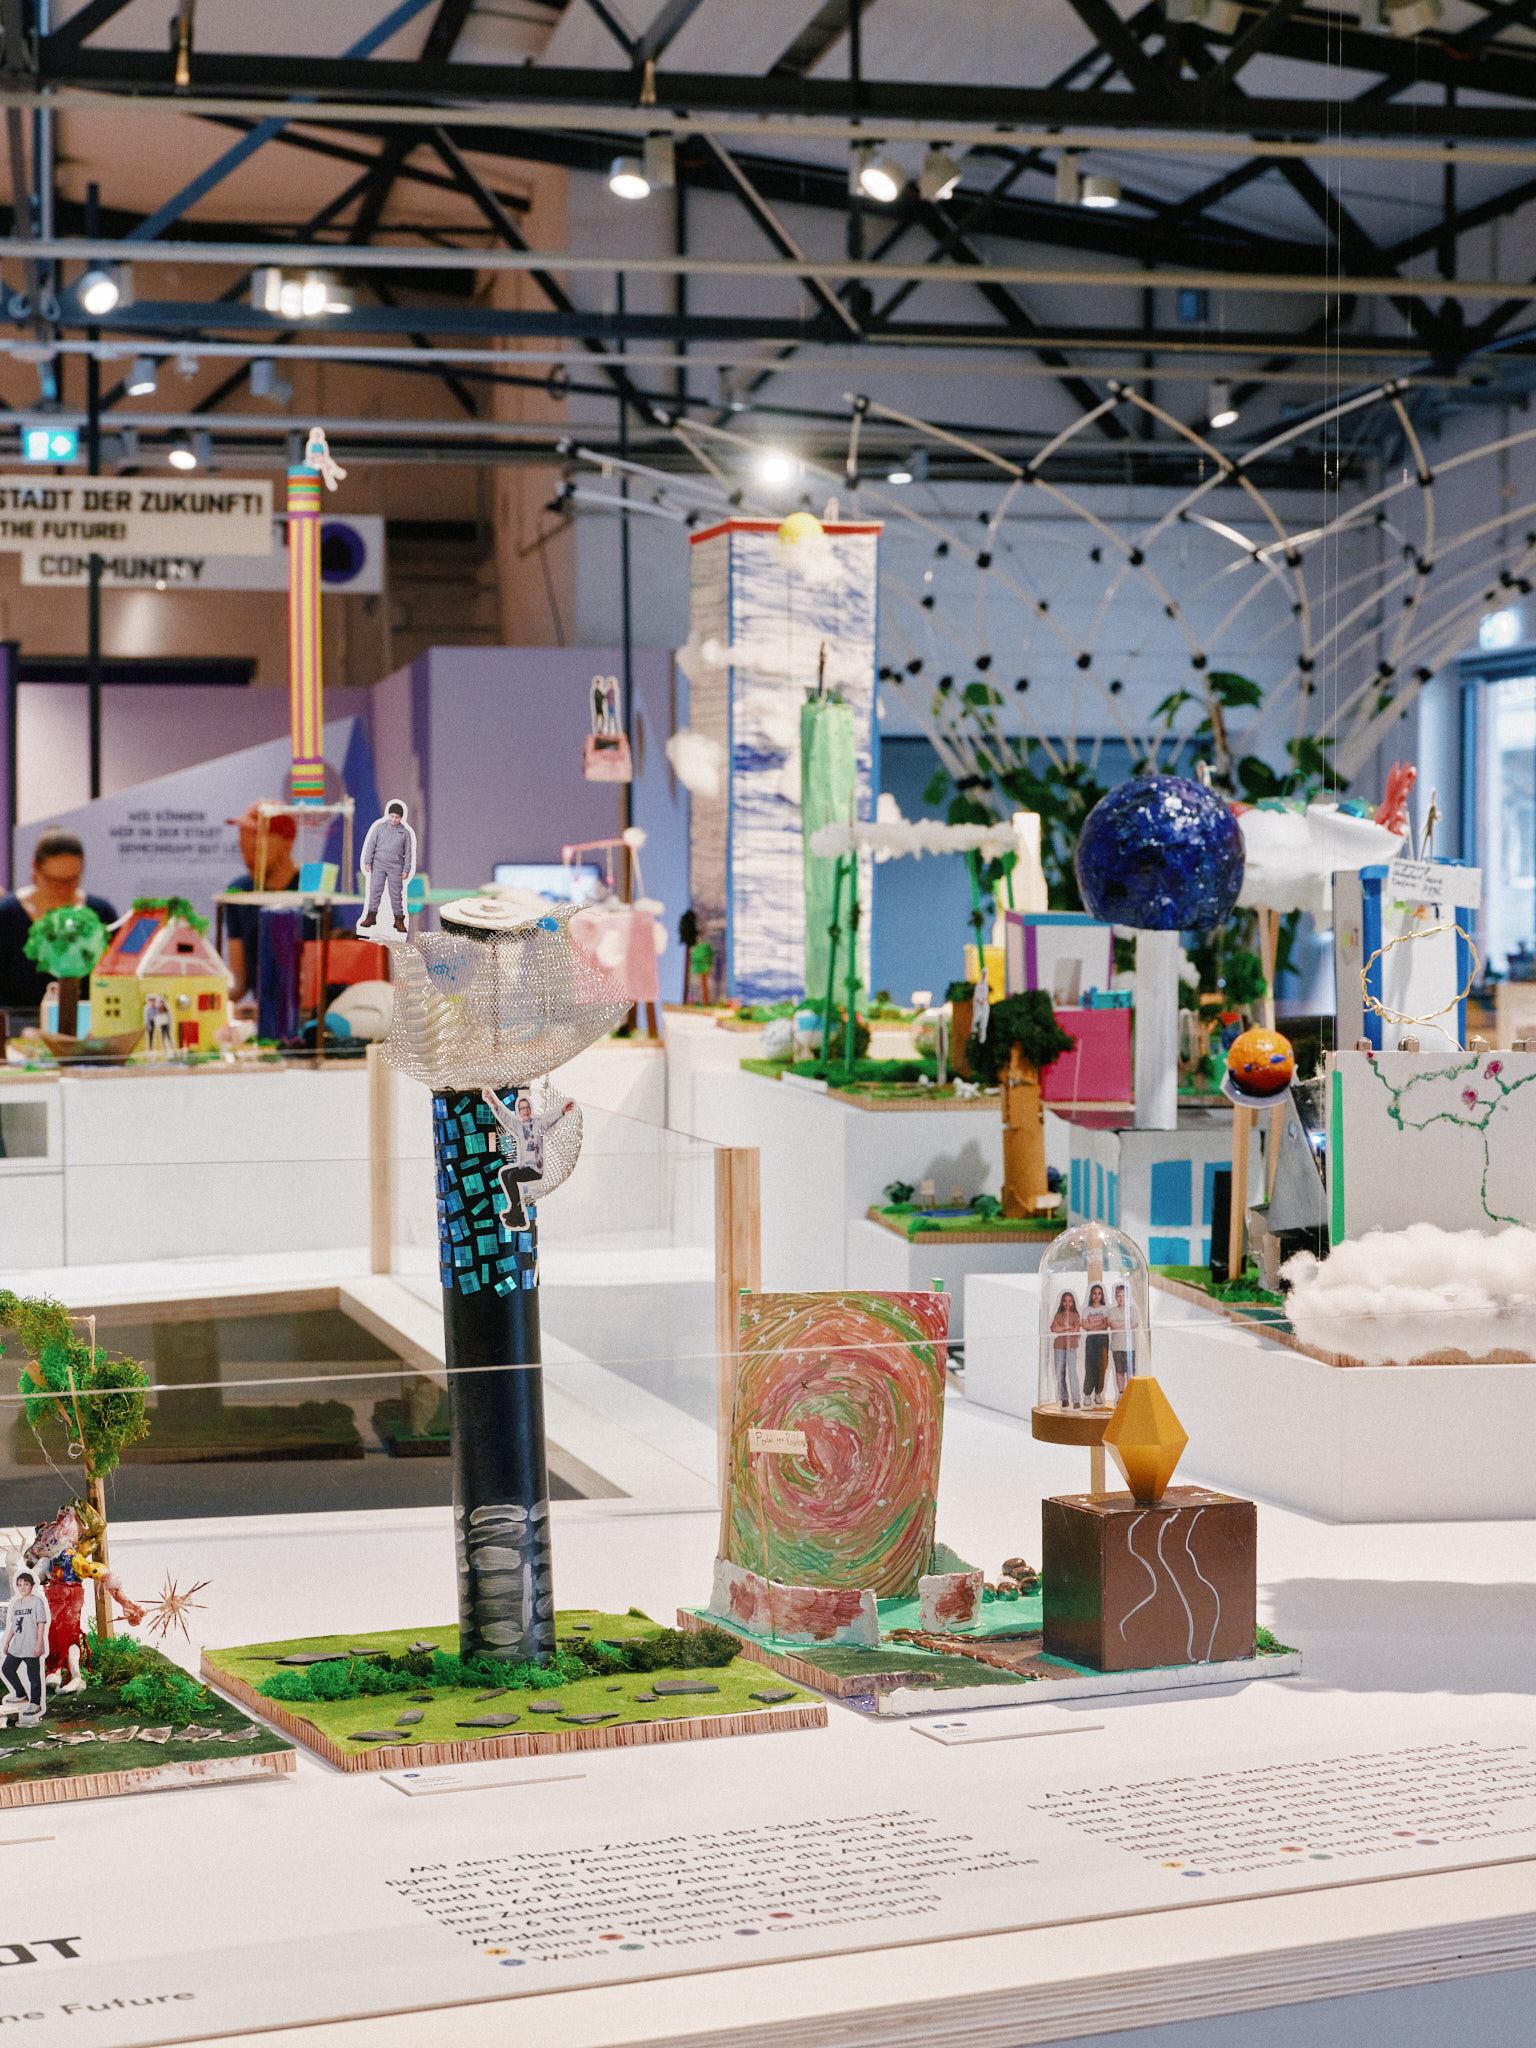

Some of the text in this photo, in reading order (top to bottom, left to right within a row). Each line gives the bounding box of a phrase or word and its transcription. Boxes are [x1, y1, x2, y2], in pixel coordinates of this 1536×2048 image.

[83, 489, 132, 511] DER
[140, 491, 263, 514] ZUKUNFT!
[0, 521, 127, 540] THE FUTURE!
[1027, 1801, 1074, 1811] how
[1114, 1790, 1152, 1800] will
[1152, 1787, 1193, 1795] live
[1222, 1776, 1275, 1787] cities
[1406, 1750, 1480, 1763] Studies
[1479, 1745, 1529, 1754] have
[1048, 1806, 1118, 1819] shown
[1120, 1799, 1164, 1809] that
[1168, 1793, 1227, 1803] when
[1231, 1782, 1313, 1796] children
[1350, 1764, 1437, 1780] involved
[1062, 1788, 1093, 1797] lot
[1099, 1784, 1120, 1792] of
[1125, 1777, 1196, 1790] people
[1201, 1772, 1234, 1780] are
[1236, 1761, 1320, 1775] working
[1388, 1743, 1456, 1756] subject
[1083, 1826, 1126, 1835] this
[1248, 1805, 1276, 1814] 60
[1282, 1795, 1366, 1809] children
[1370, 1786, 1422, 1798] aged
[1501, 1771, 1536, 1780] ha
[1104, 1827, 1186, 1843] created
[1189, 1819, 1263, 1832] visions
[1267, 1813, 1289, 1822] of
[1292, 1810, 1330, 1818] the
[1401, 1795, 1439, 1803] We
[1443, 1791, 1476, 1799] are
[1120, 1840, 1183, 1852] ideas
[1351, 1806, 1441, 1821] Symbols
[1441, 1795, 1526, 1809] indicate
[1127, 1808, 1182, 1819] cities
[1182, 1797, 1269, 1812] become
[1273, 1790, 1327, 1800] more
[1327, 1780, 1397, 1793] livable
[385, 1875, 448, 1887] tigen
[455, 1868, 501, 1879] sich
[507, 1862, 562, 1872] viele
[698, 1836, 785, 1850] Studien
[870, 1818, 938, 1828] Wenn
[397, 1882, 481, 1896] Kinder
[489, 1875, 530, 1885] bei
[538, 1870, 577, 1880] der
[585, 1858, 687, 1874] Planung
[835, 1832, 886, 1844] wird
[893, 1829, 928, 1837] die
[410, 1863, 448, 1874] Mit
[456, 1858, 509, 1868] dem
[511, 1848, 594, 1861] Thema
[598, 1835, 688, 1851] Zukunft
[722, 1828, 757, 1837] der
[764, 1820, 822, 1832] Stadt
[1143, 1846, 1225, 1861] models
[1225, 1835, 1308, 1849] belong
[1338, 1822, 1401, 1834] which
[1190, 1821, 1492, 1865] Climate Growth Supply
[1209, 1858, 1305, 1875] Expanse
[1335, 1844, 1412, 1857] Nature
[411, 1892, 478, 1906] Stadt
[485, 1888, 520, 1897] für
[532, 1882, 574, 1892] alle
[748, 1856, 786, 1865] Für
[796, 1851, 832, 1860] die
[841, 1834, 974, 1855] Ausstellung
[424, 1847, 959, 1916] haben 60 Kinder im Alter von 10 bis 12 Jahren
[439, 1915, 489, 1926] ihre
[496, 1892, 674, 1919] Zukunftsbilder
[779, 1874, 821, 1884] Die
[825, 1866, 894, 1878] Ideen
[897, 1856, 972, 1869] haben
[977, 1850, 1011, 1859] wir
[456, 1923, 518, 1936] nach
[525, 1919, 542, 1927] 6
[545, 1907, 650, 1924] Themen
[758, 1880, 863, 1898] Symbole
[961, 1858, 1040, 1872] welche
[472, 1928, 576, 1946] Modelle
[584, 1923, 614, 1932] zu
[620, 1909, 730, 1927] welchem
[732, 1898, 818, 1912] Thema
[517, 1894, 942, 1952] Klima Wachstum Versorgung
[532, 1905, 938, 1962] Weite Natur Gemeinschaft
[60, 1991, 196, 2014] Future
